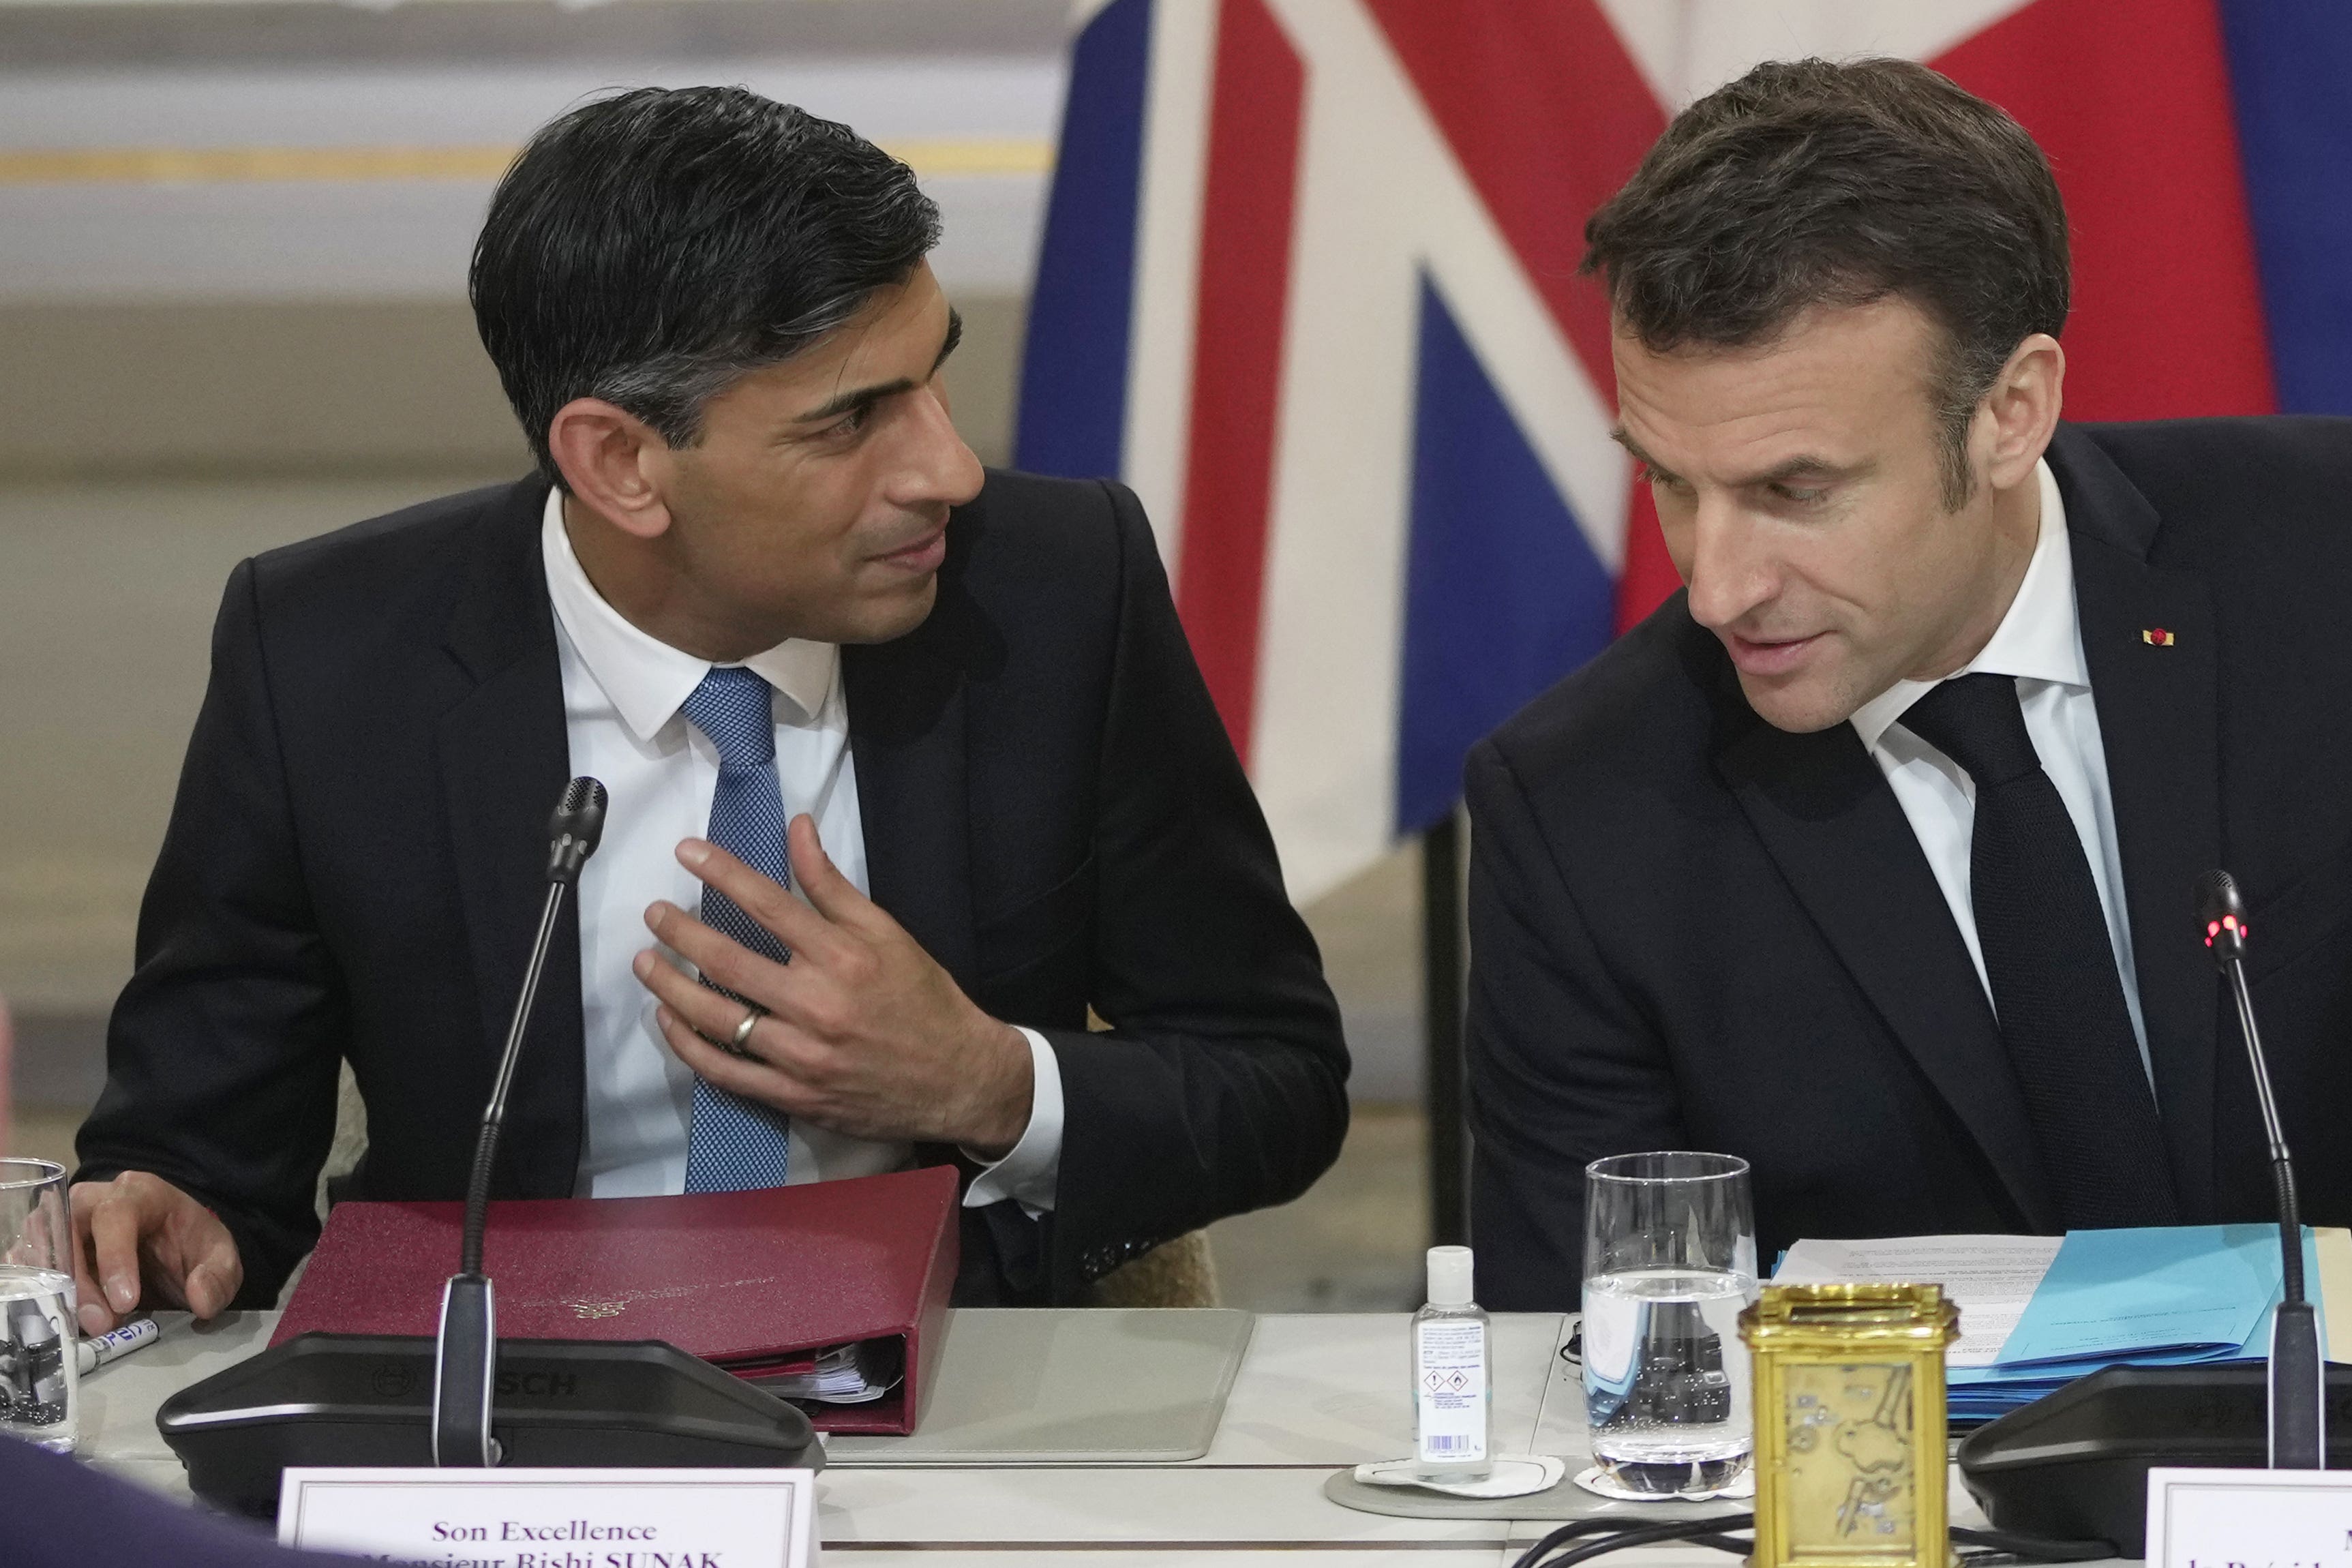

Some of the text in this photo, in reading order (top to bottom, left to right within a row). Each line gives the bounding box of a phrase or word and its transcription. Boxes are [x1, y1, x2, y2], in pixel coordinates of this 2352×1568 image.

[432, 1520, 658, 1542] Son Excellence
[516, 1552, 593, 1568] Rishi
[606, 1552, 722, 1568] SUNAK
